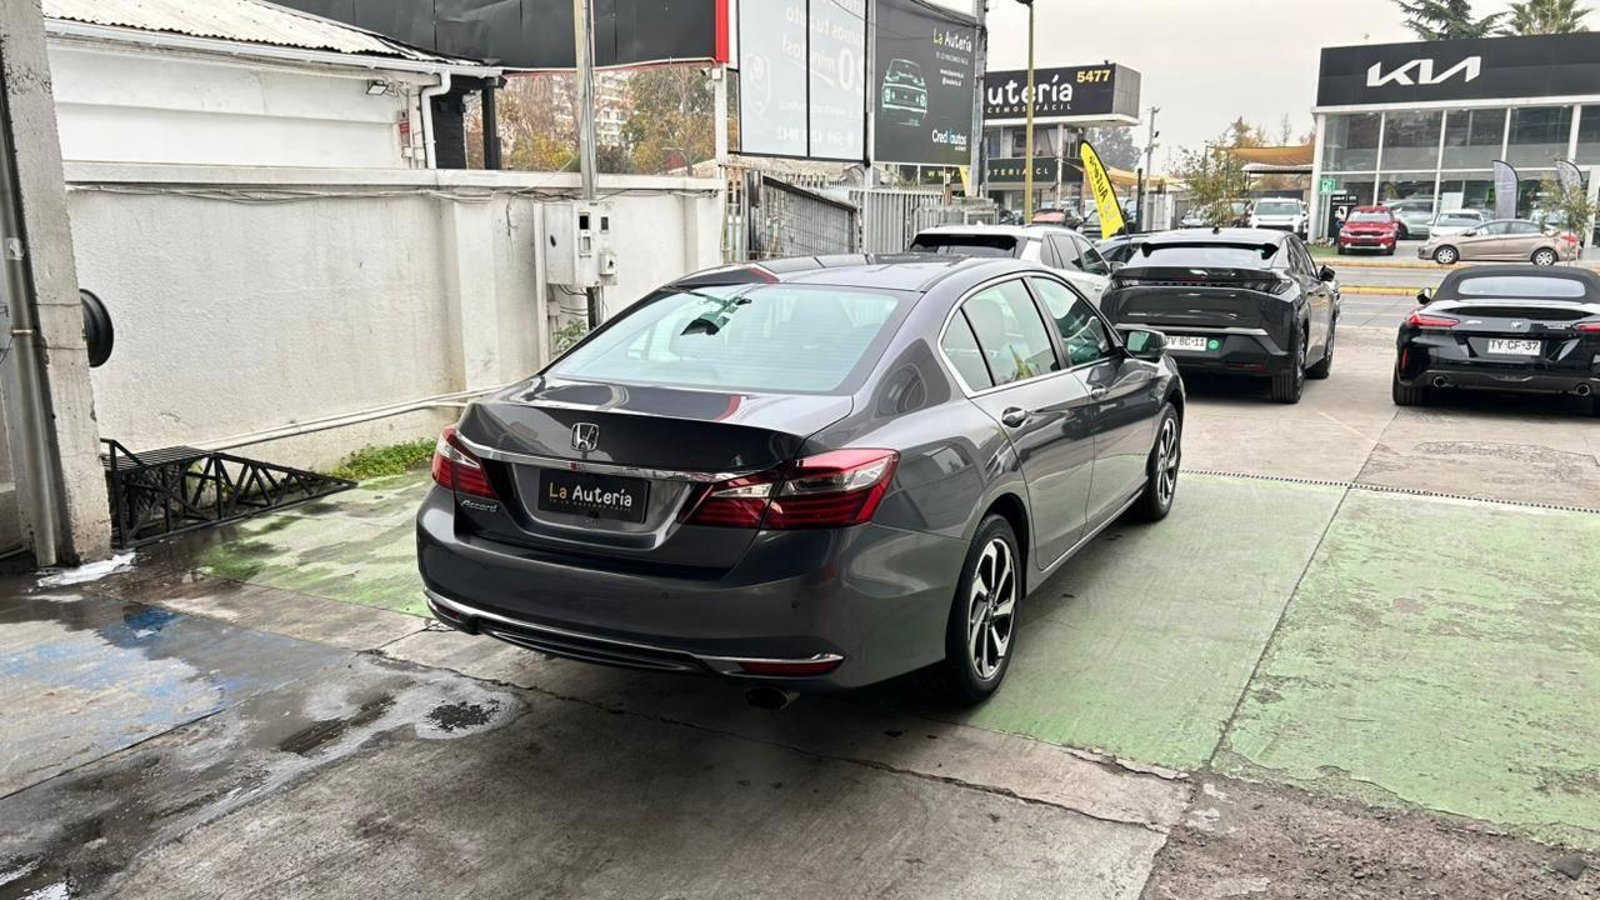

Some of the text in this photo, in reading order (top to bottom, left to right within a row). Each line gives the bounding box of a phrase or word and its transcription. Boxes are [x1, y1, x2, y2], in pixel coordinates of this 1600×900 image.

[933, 28, 943, 45] La
[1076, 69, 1111, 83] 5477
[1366, 55, 1481, 87] KIA
[549, 482, 567, 499] La
[572, 485, 632, 507] Autería
[460, 500, 498, 513] Accord
